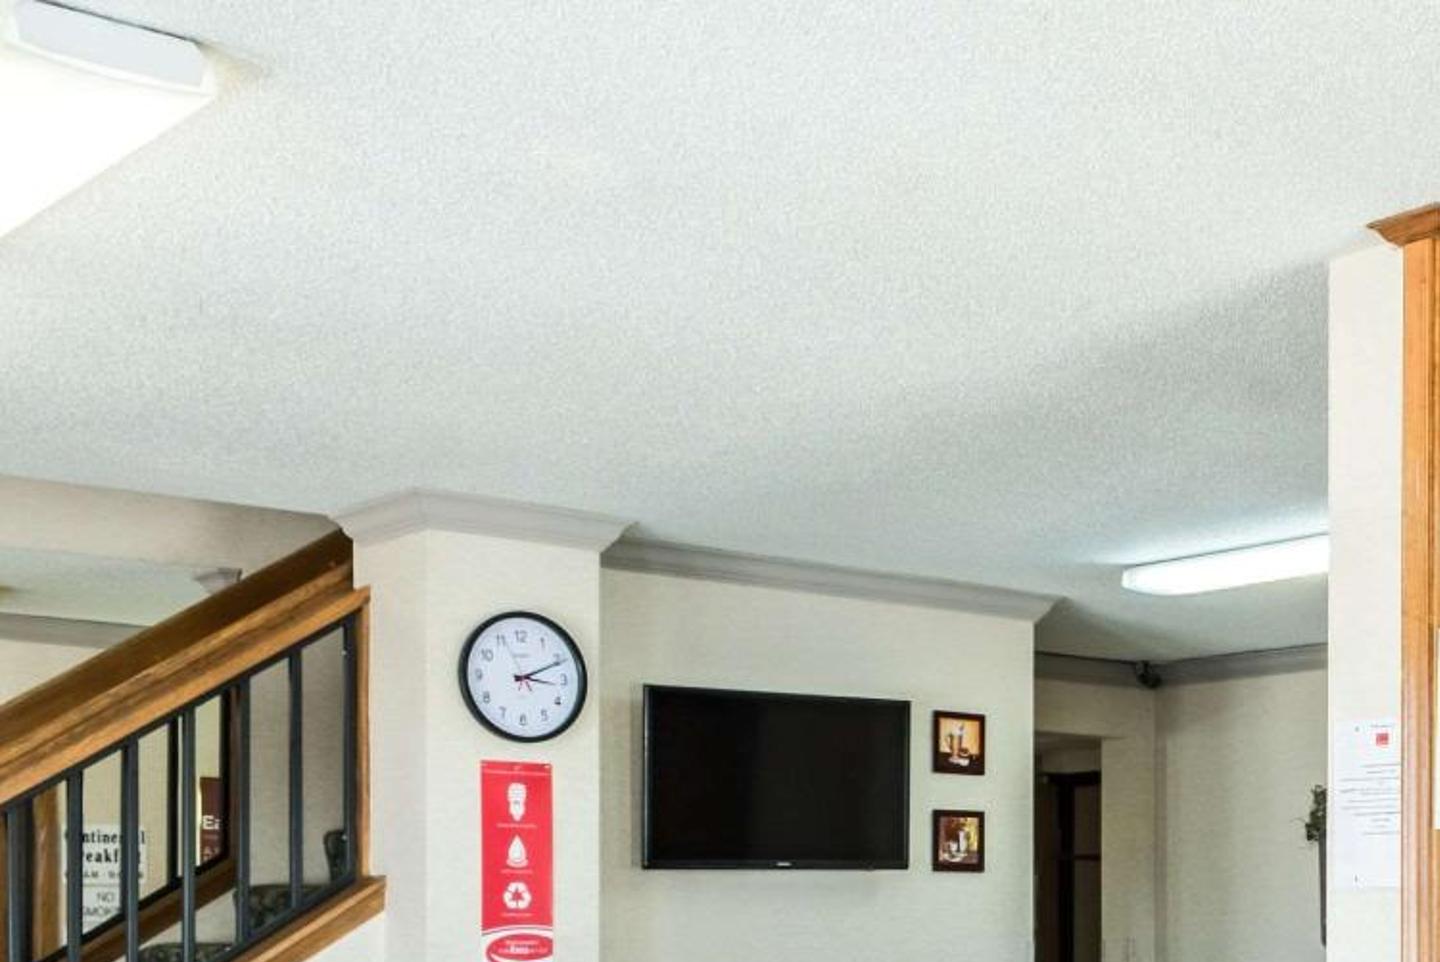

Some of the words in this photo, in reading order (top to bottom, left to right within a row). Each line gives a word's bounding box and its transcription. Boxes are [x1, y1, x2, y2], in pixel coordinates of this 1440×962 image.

[496, 634, 506, 647] 11
[514, 630, 528, 643] 12
[540, 637, 546, 649] 1
[481, 648, 494, 662] 10
[474, 668, 483, 680] 9
[559, 673, 568, 686] 3
[482, 691, 491, 704] 8
[553, 696, 562, 706] 4
[498, 705, 507, 718] 7
[540, 709, 549, 722] 5
[519, 713, 527, 726] 6
